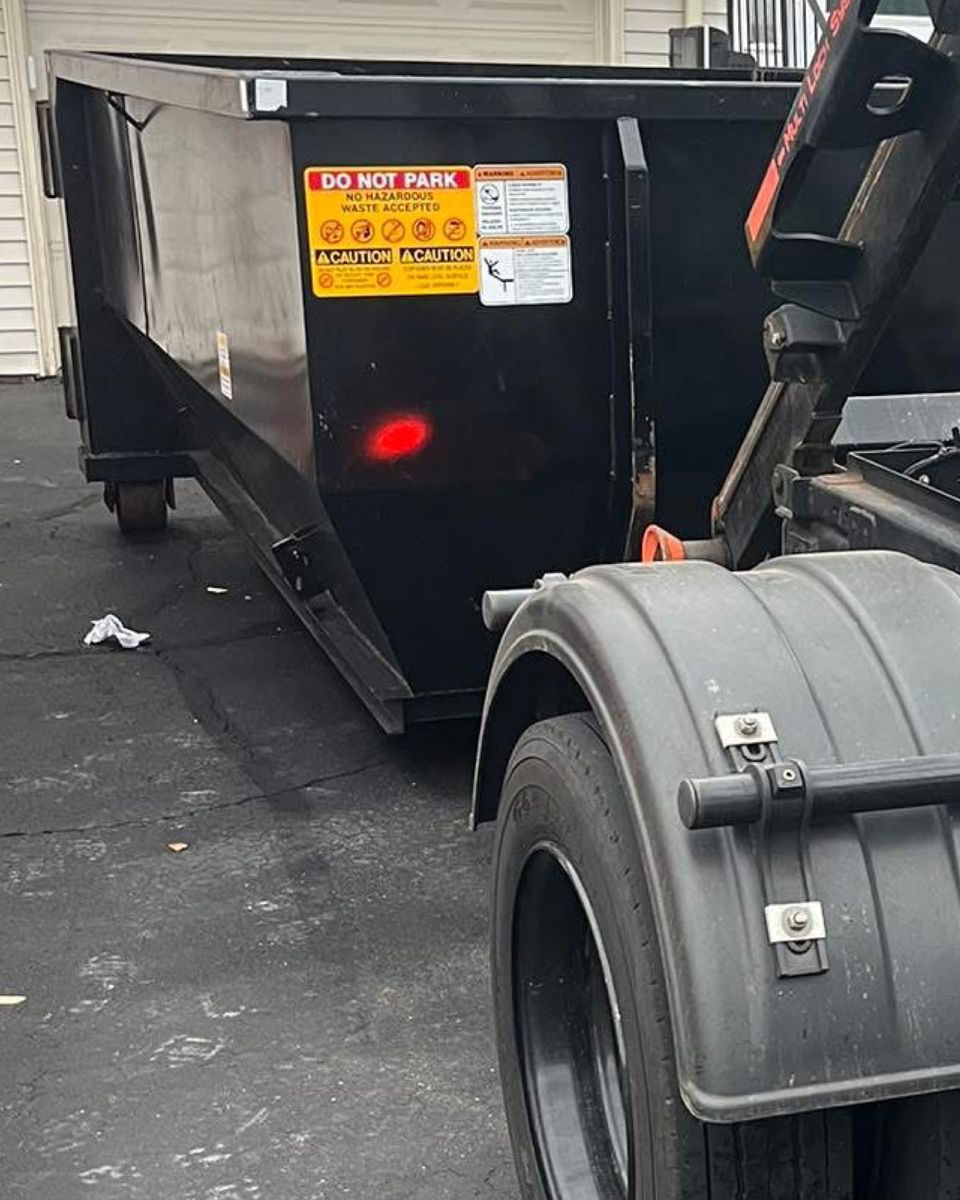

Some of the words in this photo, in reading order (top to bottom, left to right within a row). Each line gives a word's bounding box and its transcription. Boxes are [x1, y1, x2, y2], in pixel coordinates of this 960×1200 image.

[321, 173, 351, 189] DO
[357, 173, 397, 189] NOT
[404, 172, 458, 188] PARK
[345, 193, 362, 202] NO
[365, 192, 433, 202] HAZARDOUS
[341, 204, 377, 213] WASTE
[382, 202, 440, 212] ACCEPTED
[329, 250, 392, 263] CAUTION
[413, 248, 474, 262] CAUTION
